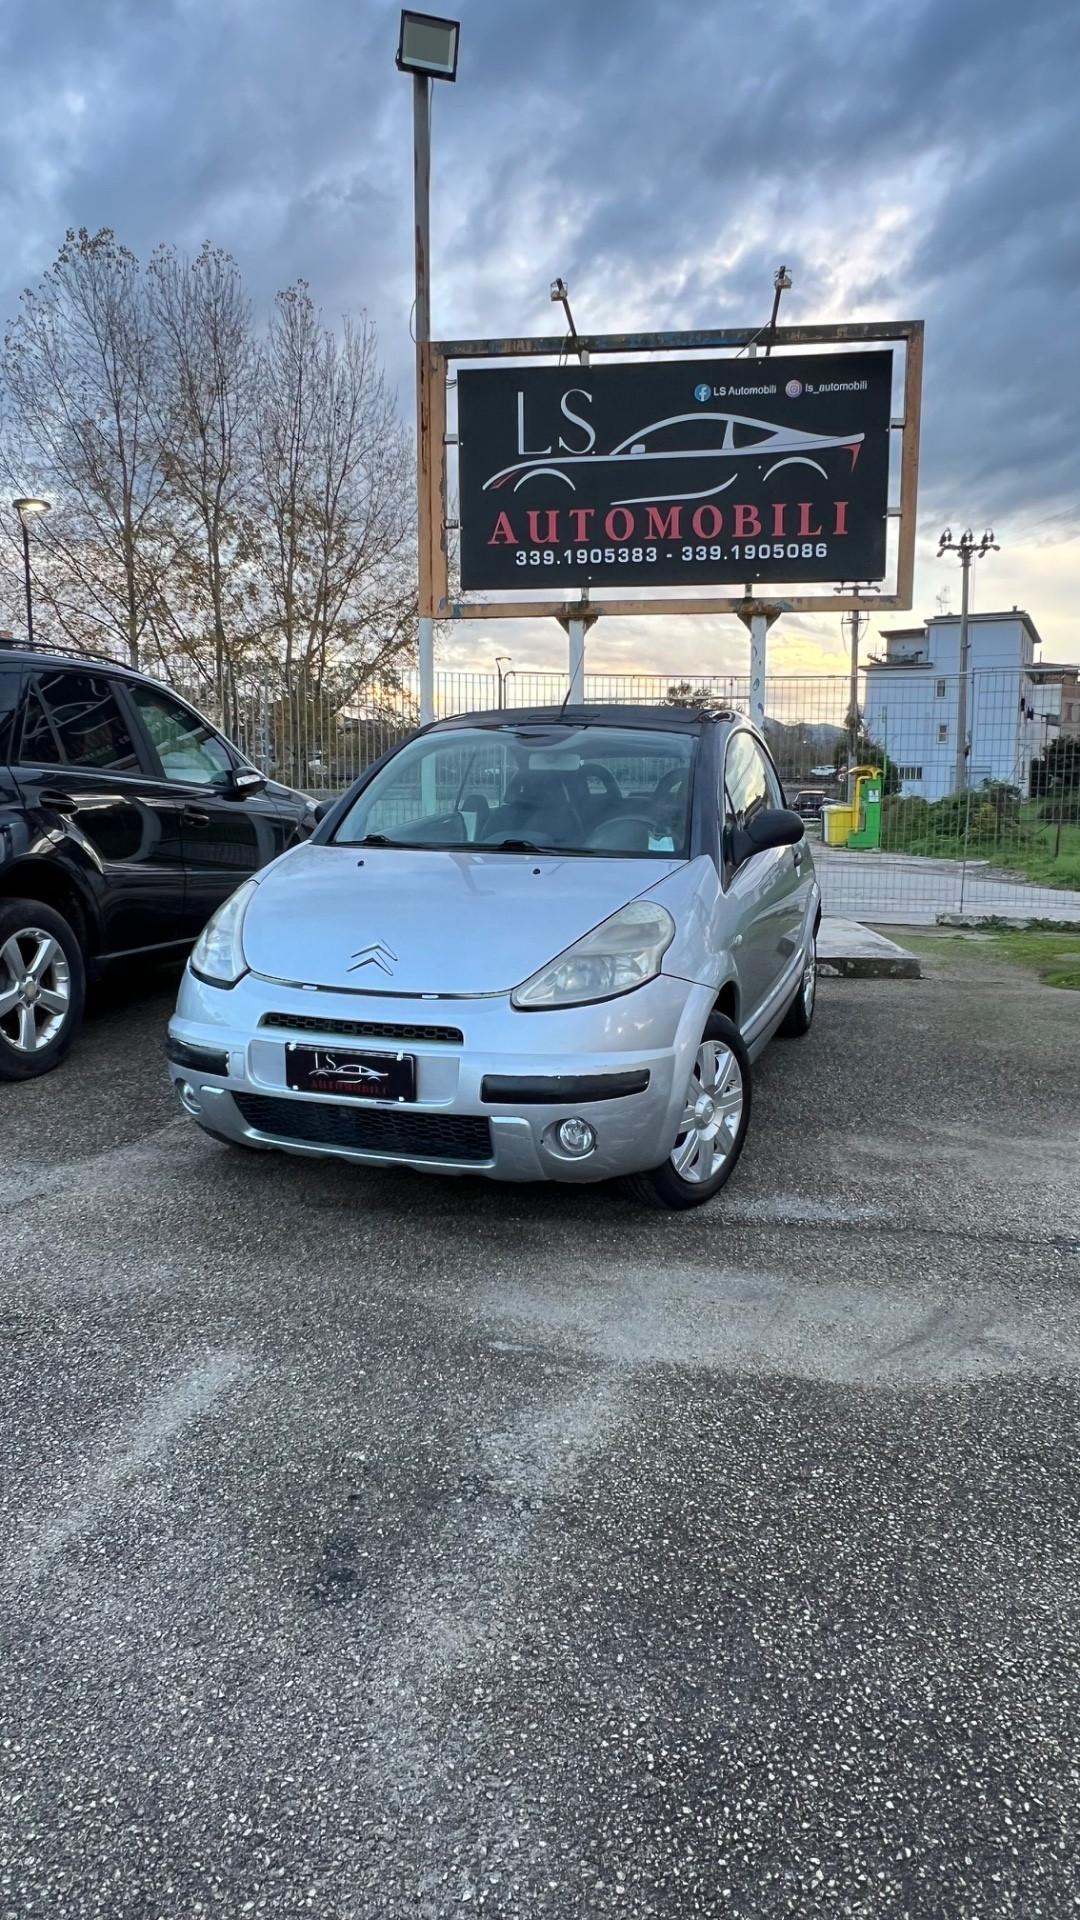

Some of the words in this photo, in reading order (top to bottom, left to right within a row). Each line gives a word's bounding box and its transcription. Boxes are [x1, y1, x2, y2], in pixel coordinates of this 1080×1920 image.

[713, 385, 727, 397] LS
[728, 384, 777, 396] Automobili
[805, 380, 868, 394] ls_automobili
[487, 501, 849, 544] AUTOMOBILI
[515, 547, 657, 566] 339.1905383
[681, 543, 828, 561] 339.1905086
